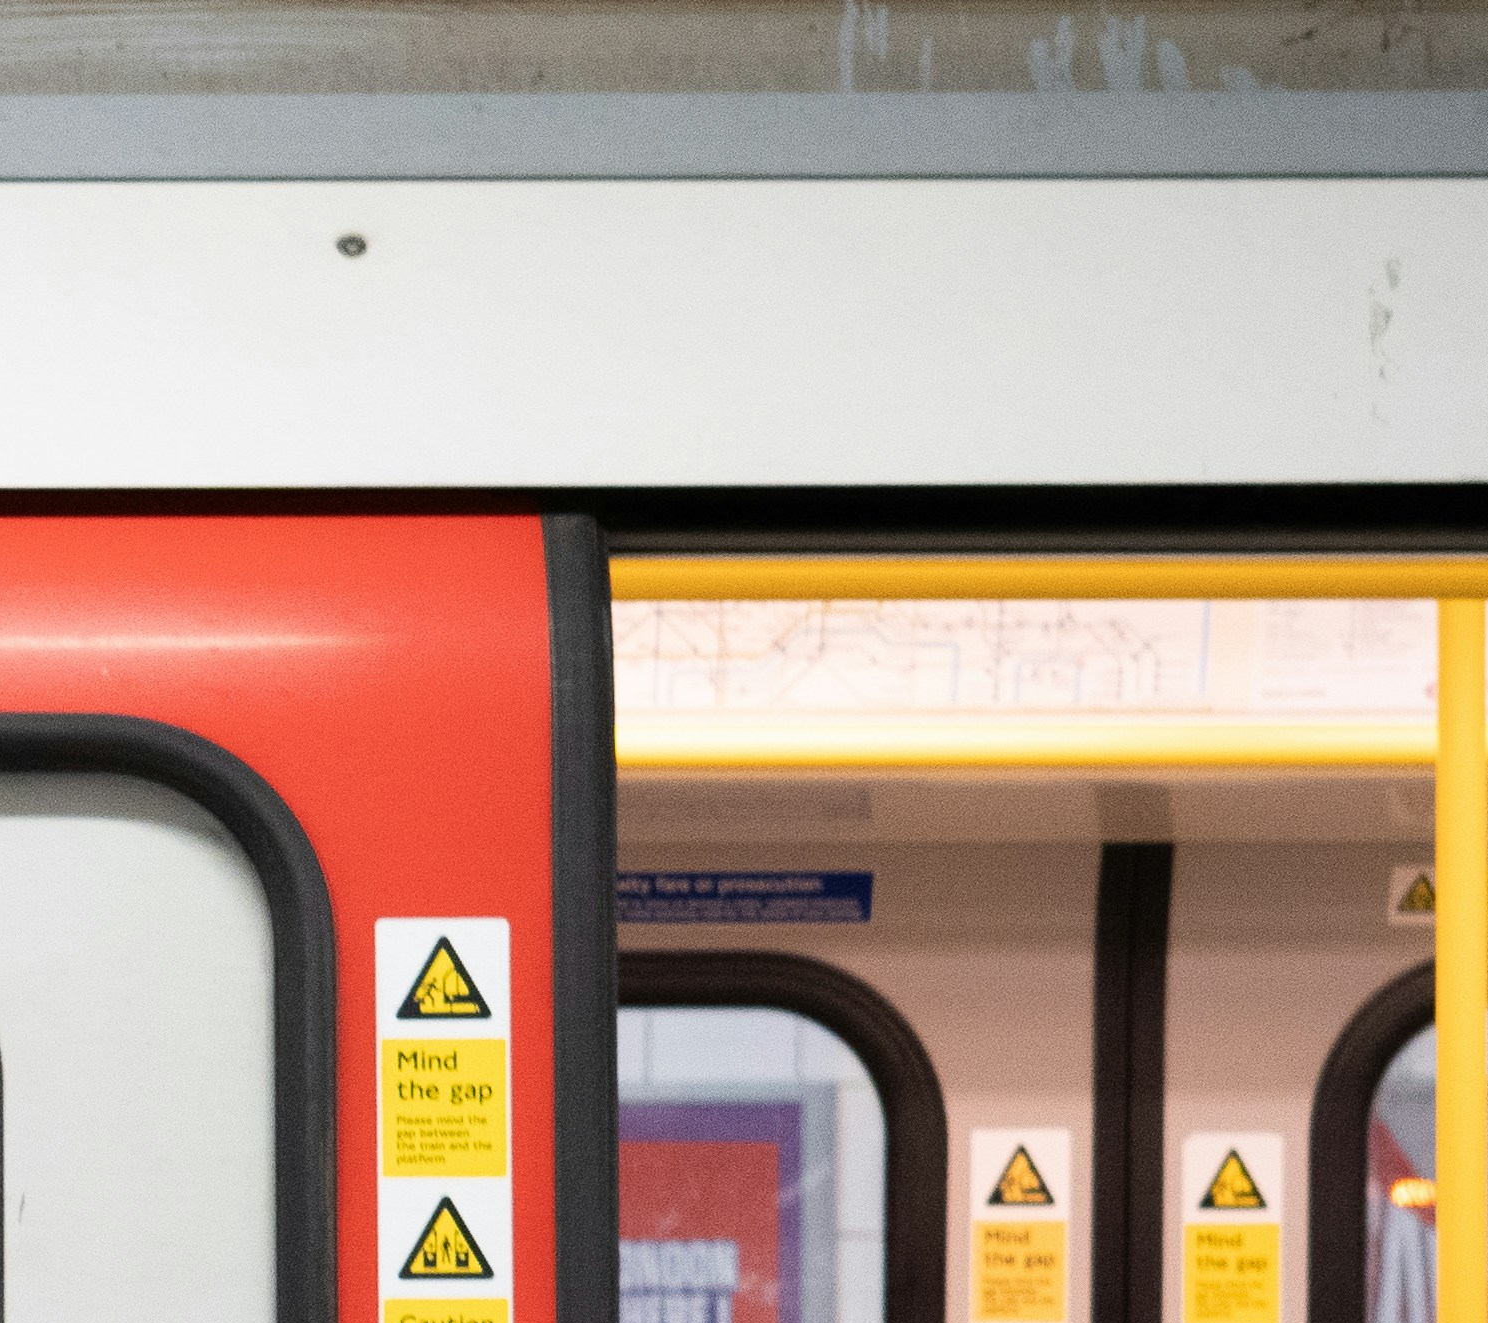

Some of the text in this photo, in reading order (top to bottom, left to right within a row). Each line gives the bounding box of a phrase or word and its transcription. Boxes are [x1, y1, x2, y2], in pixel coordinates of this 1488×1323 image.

[397, 1048, 458, 1071] Mind
[397, 1079, 493, 1105] the gap
[1024, 1255, 1055, 1269] gap
